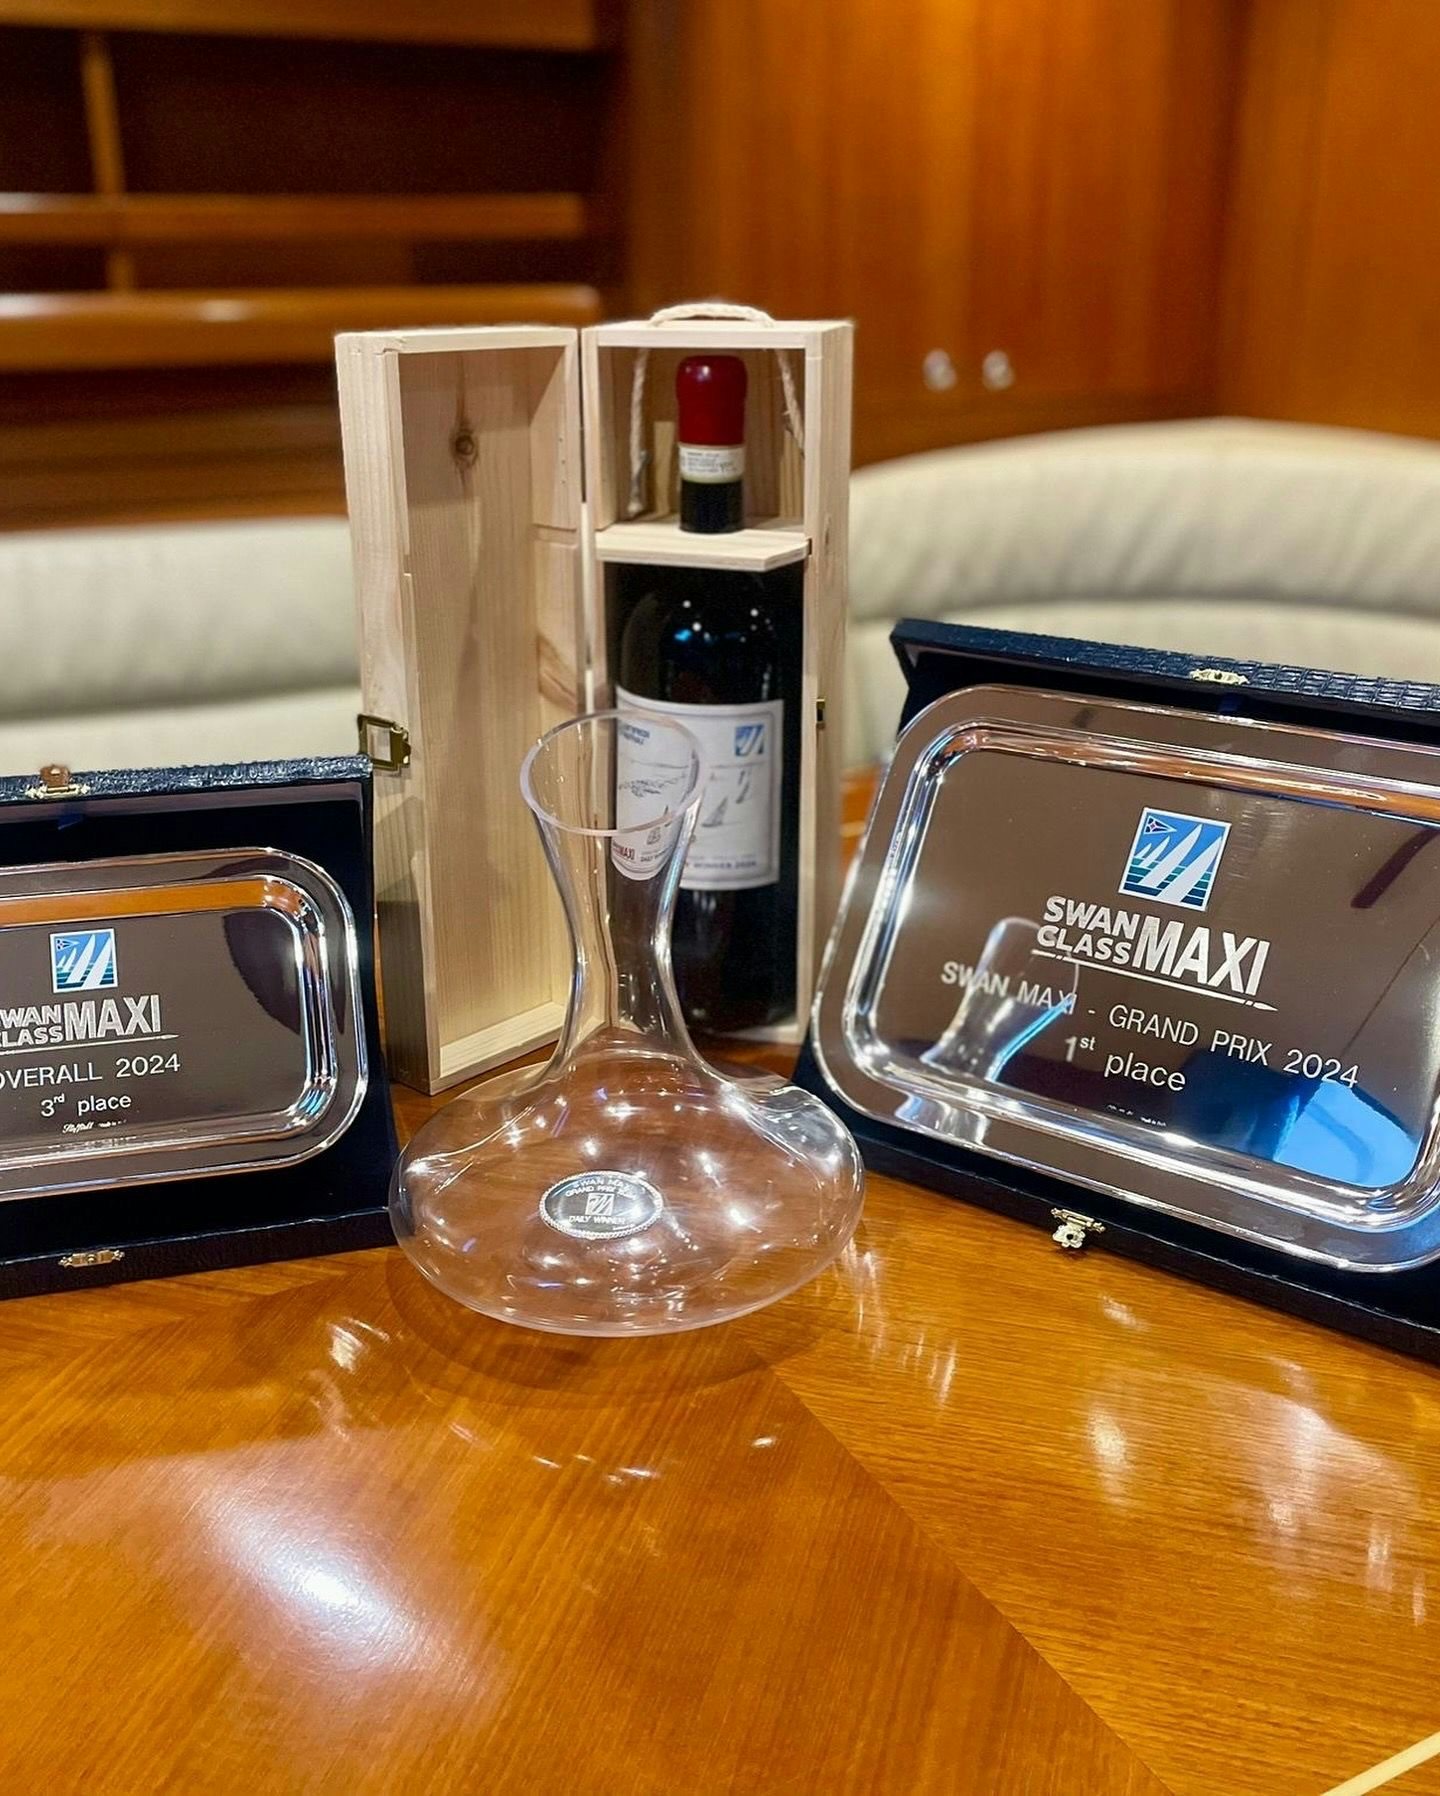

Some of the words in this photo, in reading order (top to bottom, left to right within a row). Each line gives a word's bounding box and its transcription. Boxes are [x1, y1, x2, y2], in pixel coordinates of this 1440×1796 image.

[1037, 925, 1132, 966] CLASS
[1043, 896, 1140, 940] SWAN
[1132, 916, 1270, 996] MAXI
[0, 1004, 61, 1029] WAN
[64, 994, 162, 1042] MAXI
[941, 961, 1010, 997] SWAN
[1017, 980, 1078, 1016] MAXI
[1108, 1004, 1199, 1047] GRAND
[1210, 1029, 1272, 1066] PRIX
[1283, 1049, 1359, 1089] 2024
[0, 1025, 64, 1048] LASS
[1064, 1035, 1097, 1063] 1st
[115, 1053, 181, 1079] 2024
[1104, 1052, 1186, 1092] place
[40, 1093, 66, 1117] 3rd
[77, 1094, 132, 1116] place
[565, 1185, 595, 1197] GRAND
[568, 1215, 592, 1223] DAILY
